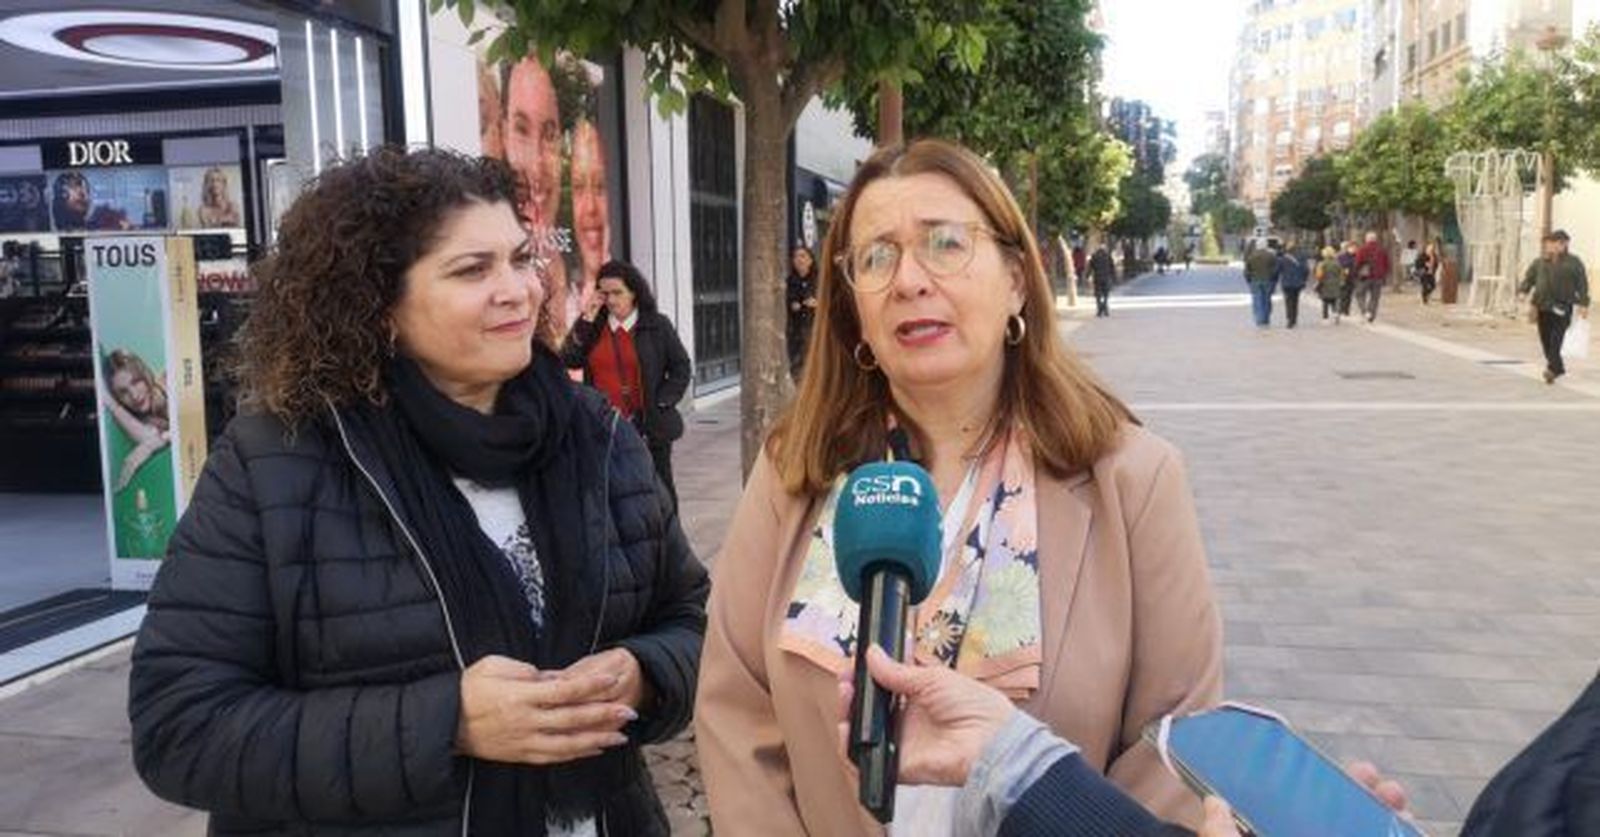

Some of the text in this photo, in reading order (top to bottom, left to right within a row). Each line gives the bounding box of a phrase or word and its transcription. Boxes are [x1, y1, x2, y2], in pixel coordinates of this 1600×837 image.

[67, 140, 133, 166] DIOR
[92, 243, 157, 268] TOUS
[854, 492, 919, 507] Noticias
